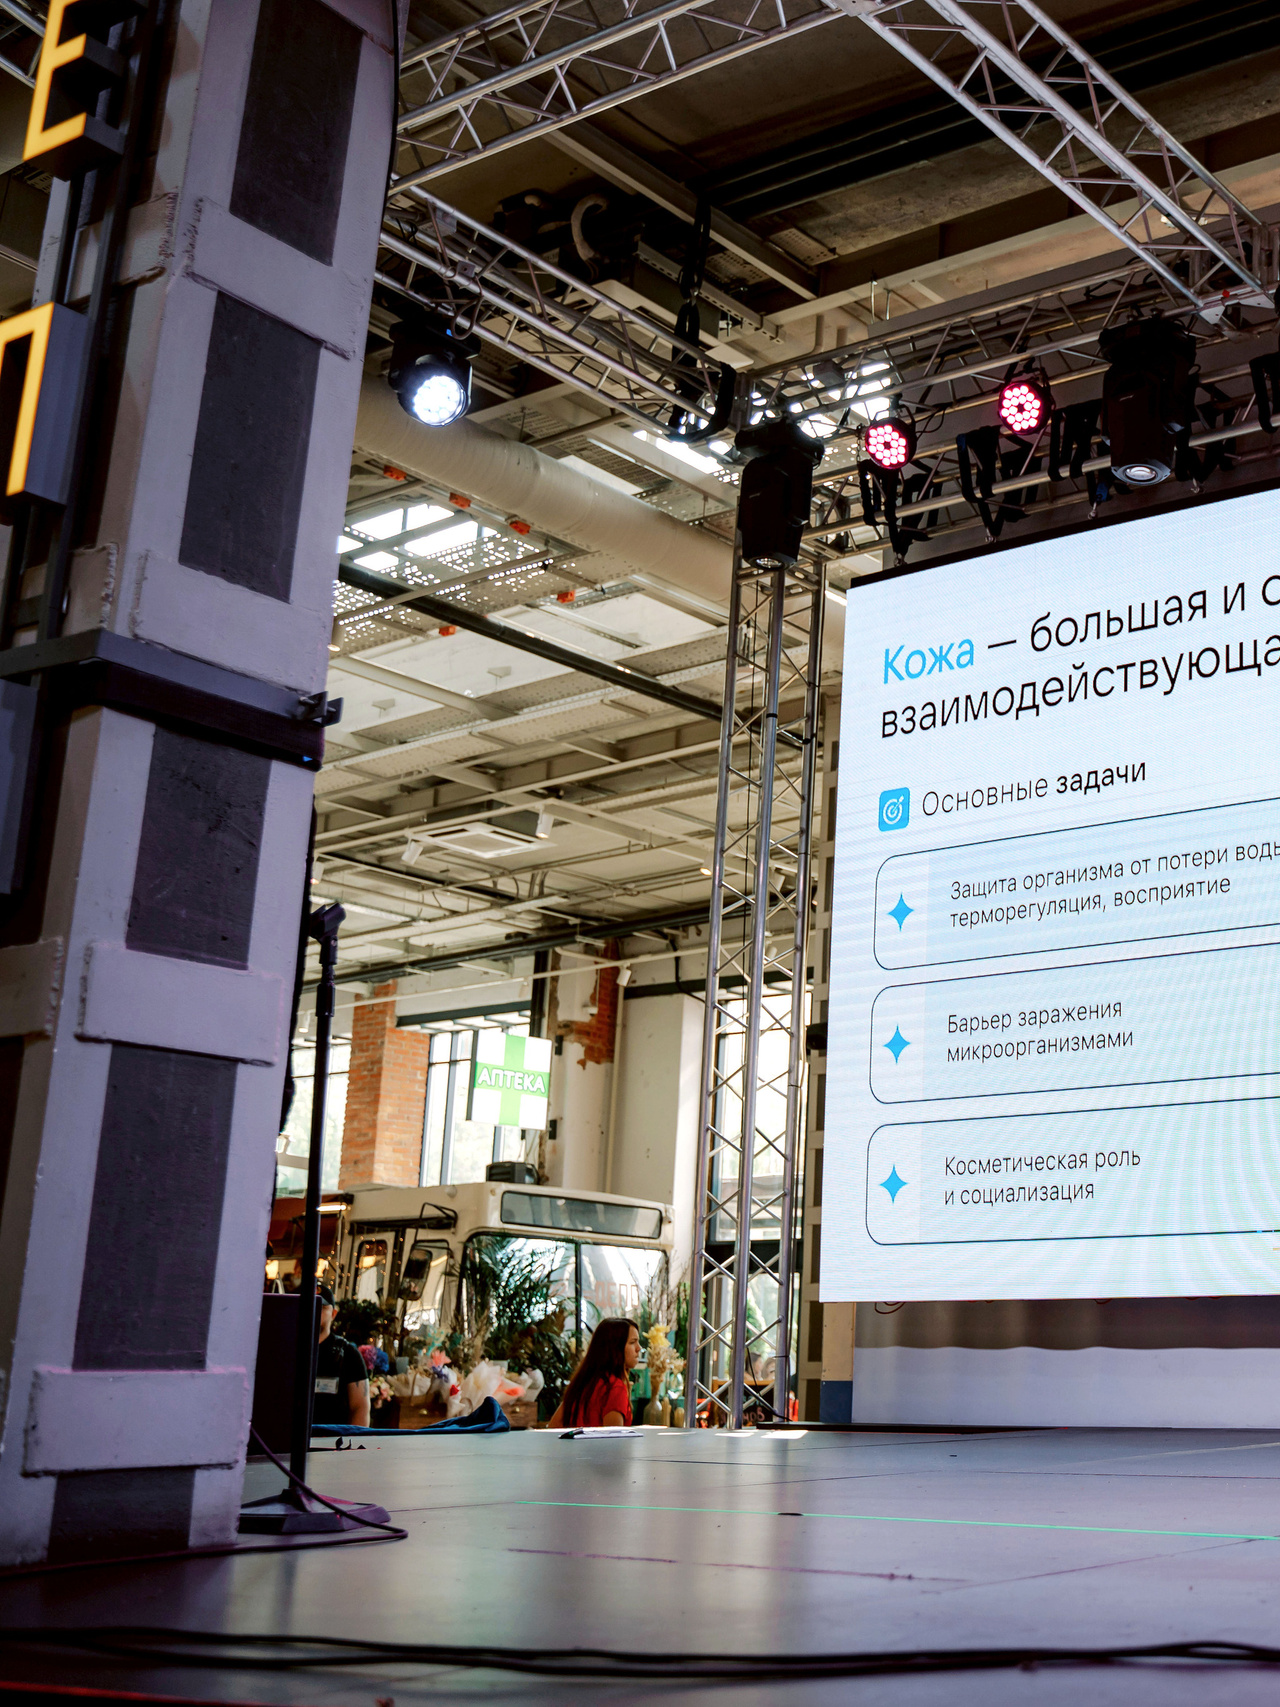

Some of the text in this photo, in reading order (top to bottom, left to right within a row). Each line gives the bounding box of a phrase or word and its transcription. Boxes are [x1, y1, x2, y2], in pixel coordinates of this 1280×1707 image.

[883, 638, 975, 684] Кожа
[1030, 590, 1207, 652] большая
[1224, 582, 1245, 614] и
[922, 762, 1146, 816] Основные задачи
[951, 874, 1018, 902] Защита
[1022, 860, 1124, 895] организма
[1130, 856, 1151, 876] от
[1157, 844, 1229, 876] потери
[950, 876, 1231, 928] терморегуляция, восприятие
[947, 1000, 1122, 1036] Барьер заражения
[947, 1030, 1134, 1062] микроорганизмами
[478, 1066, 546, 1094] АПТЕКА
[944, 1148, 1141, 1177] Косметическая роль
[944, 1182, 1094, 1207] и социализация
